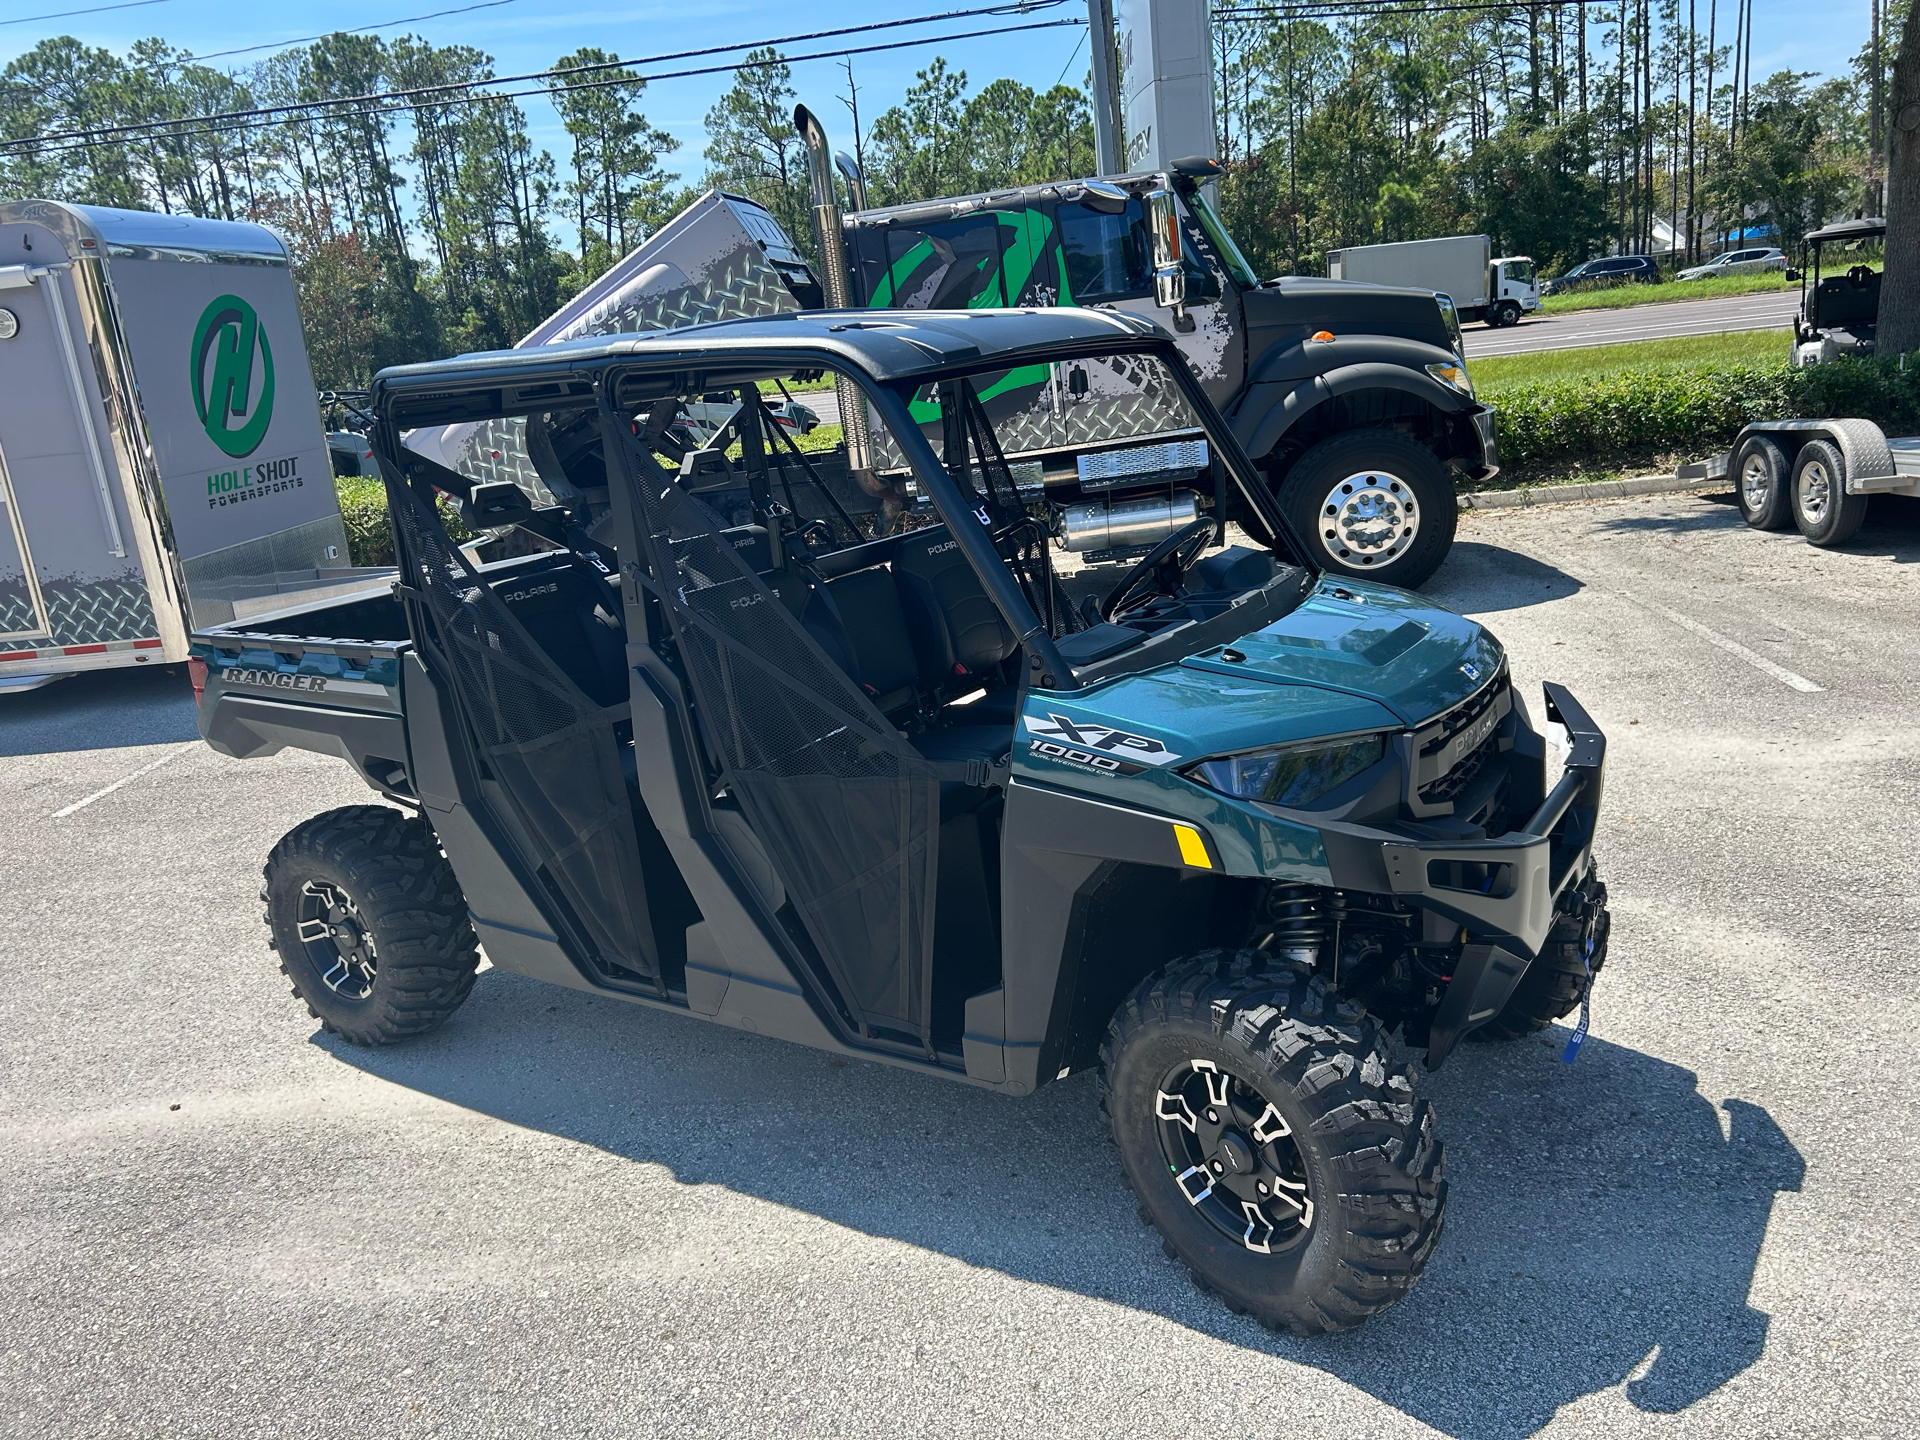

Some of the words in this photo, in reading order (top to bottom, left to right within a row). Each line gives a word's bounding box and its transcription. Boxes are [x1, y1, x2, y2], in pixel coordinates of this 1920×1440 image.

[207, 467, 254, 496] HOLE
[256, 457, 299, 485] SHOT
[208, 477, 304, 510] POWERSPORTS
[504, 583, 558, 604] POLARIS
[227, 668, 327, 691] RANGER
[1031, 712, 1167, 753] XP
[1029, 739, 1121, 771] 1000
[1029, 751, 1051, 761] DUAL
[1051, 757, 1095, 773] OVERHEAD
[1096, 768, 1116, 778] CAM
[1572, 982, 1591, 1044] POLARIS
